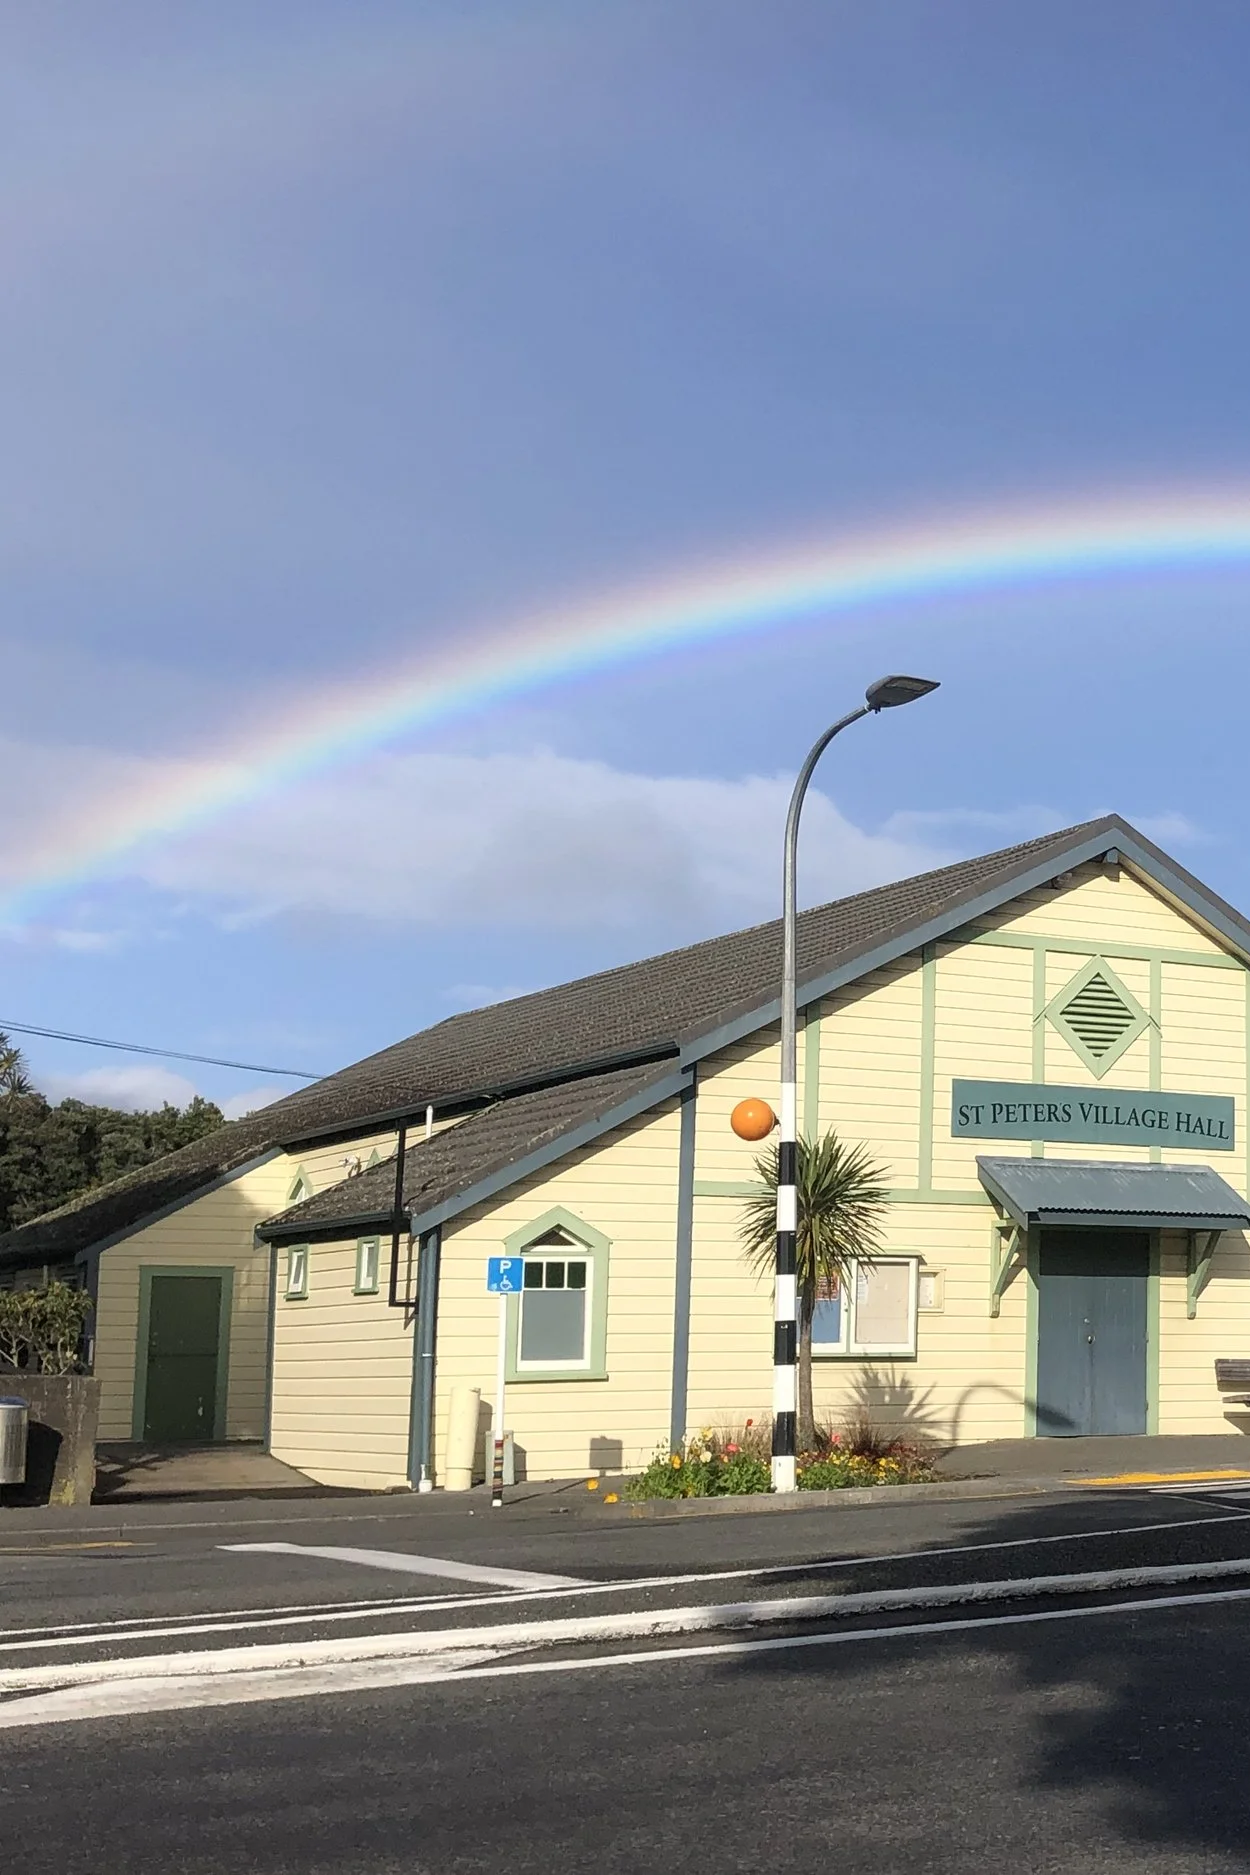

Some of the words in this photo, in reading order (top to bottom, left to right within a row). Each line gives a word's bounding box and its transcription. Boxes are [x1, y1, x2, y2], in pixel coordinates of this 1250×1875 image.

[958, 1104, 985, 1126] ST
[1078, 1102, 1169, 1130] VILLAGE
[1175, 1111, 1230, 1140] HALL
[500, 1260, 512, 1274] P
